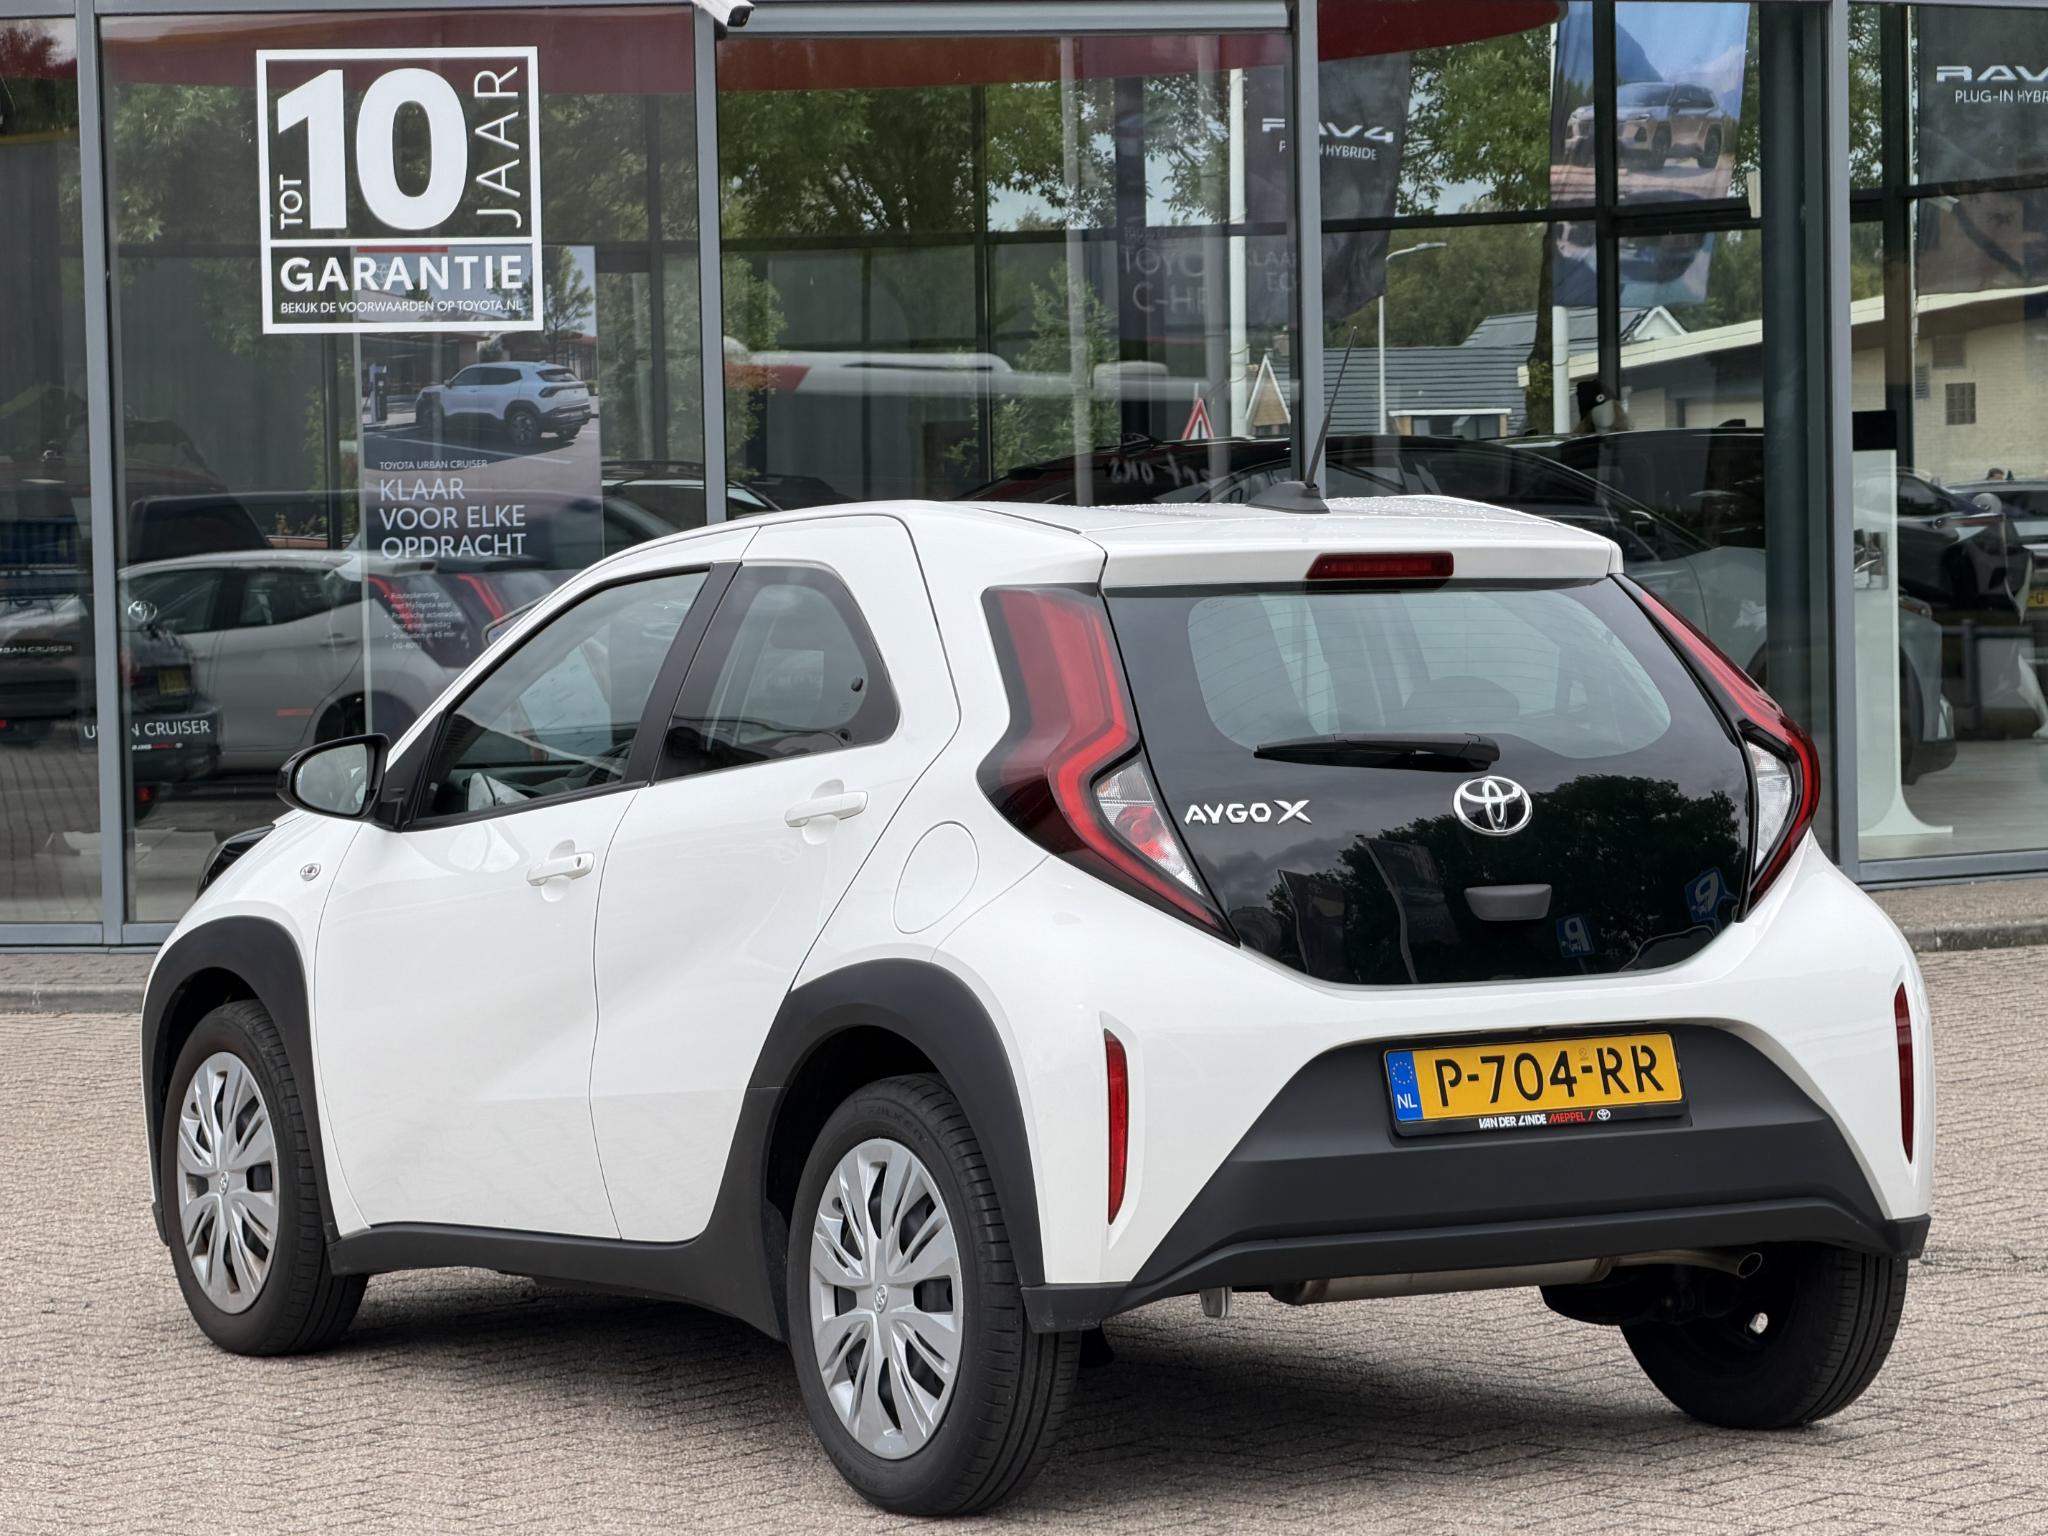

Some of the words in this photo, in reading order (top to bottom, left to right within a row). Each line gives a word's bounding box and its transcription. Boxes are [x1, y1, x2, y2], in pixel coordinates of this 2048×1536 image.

[1955, 89, 2014, 104] PLUG-IN
[277, 67, 468, 231] 10
[474, 66, 522, 228] JAAR
[1326, 143, 1377, 160] HYBRIDE
[280, 174, 303, 230] TOT
[280, 255, 523, 293] GARANTIE
[280, 302, 318, 314] BEKIJK
[320, 302, 337, 314] DE
[339, 301, 435, 313] VOORWAARDEN
[437, 300, 455, 312] OP
[457, 300, 523, 312] TOYOTA.NL
[380, 461, 415, 470] TOYOTA
[416, 460, 448, 470] URBAN
[450, 459, 489, 469] CRUISER
[380, 478, 465, 501] KLAAR
[379, 506, 459, 530] VOOR
[467, 504, 526, 528] ELKE
[381, 533, 527, 560] OPDRACHT
[144, 719, 211, 737] CRUISER
[1184, 803, 1272, 825] AYGO
[1435, 1045, 1664, 1107] P-704-RR
[1397, 1093, 1417, 1110] NL
[1479, 1117, 1498, 1129] VAN
[1499, 1116, 1517, 1128] DER
[1518, 1113, 1547, 1126] LINDE
[1549, 1111, 1586, 1125] MEPPEL
